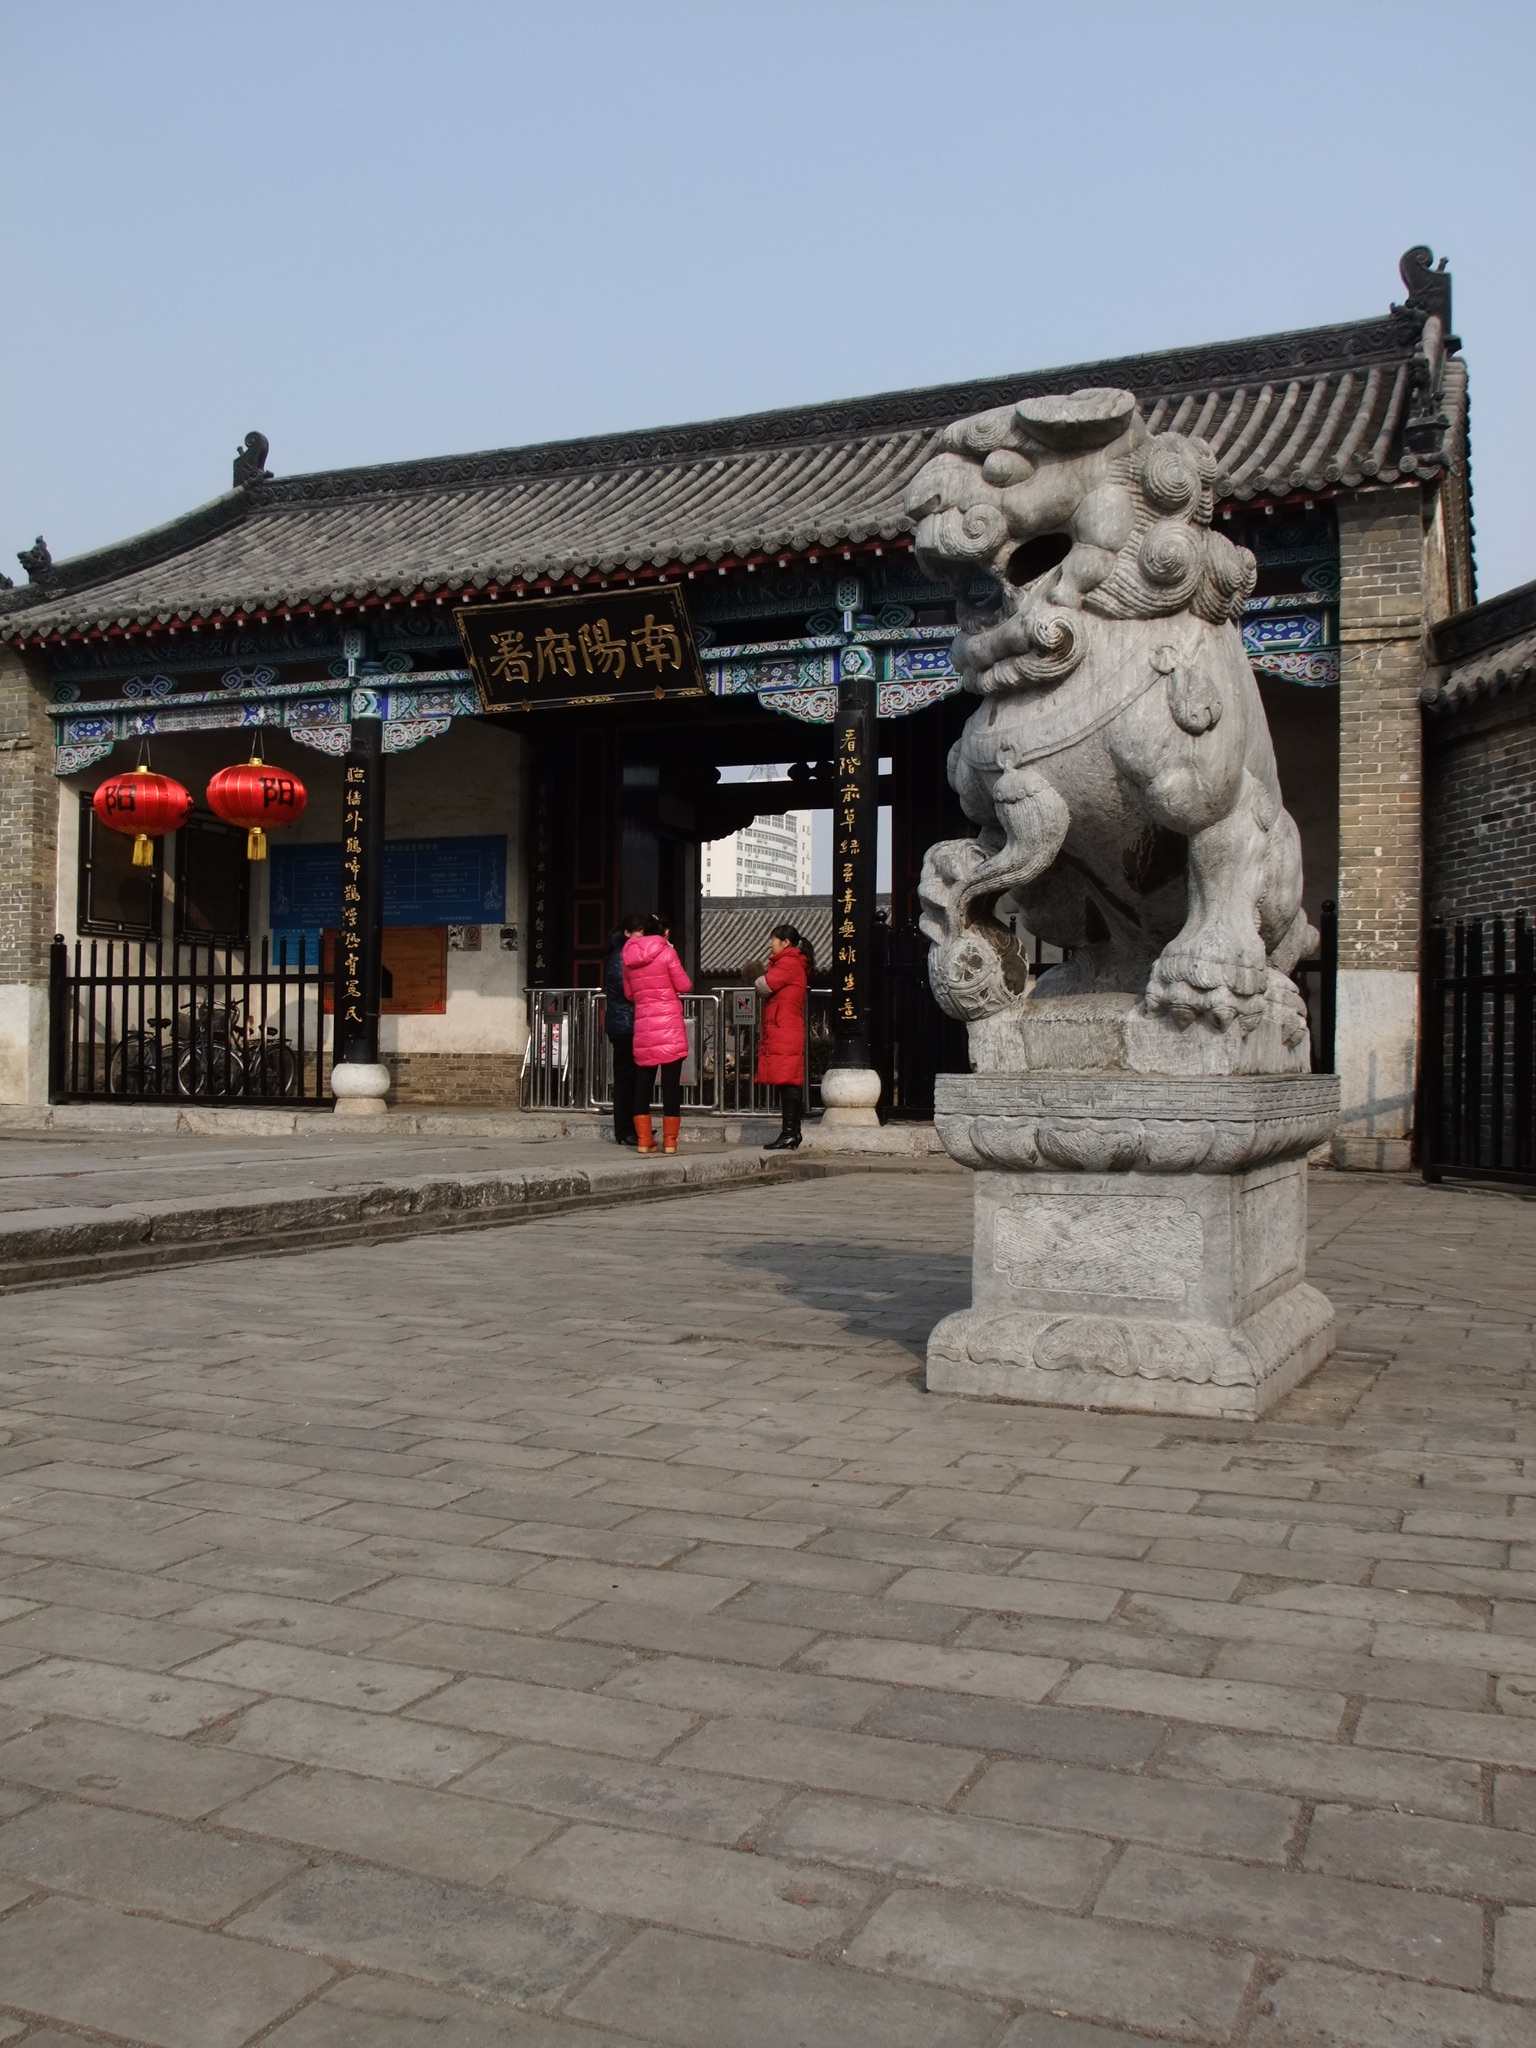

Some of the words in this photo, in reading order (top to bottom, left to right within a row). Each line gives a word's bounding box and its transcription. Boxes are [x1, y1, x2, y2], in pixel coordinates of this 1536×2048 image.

[488, 613, 683, 685] 南陽府署
[259, 777, 296, 809] 阳
